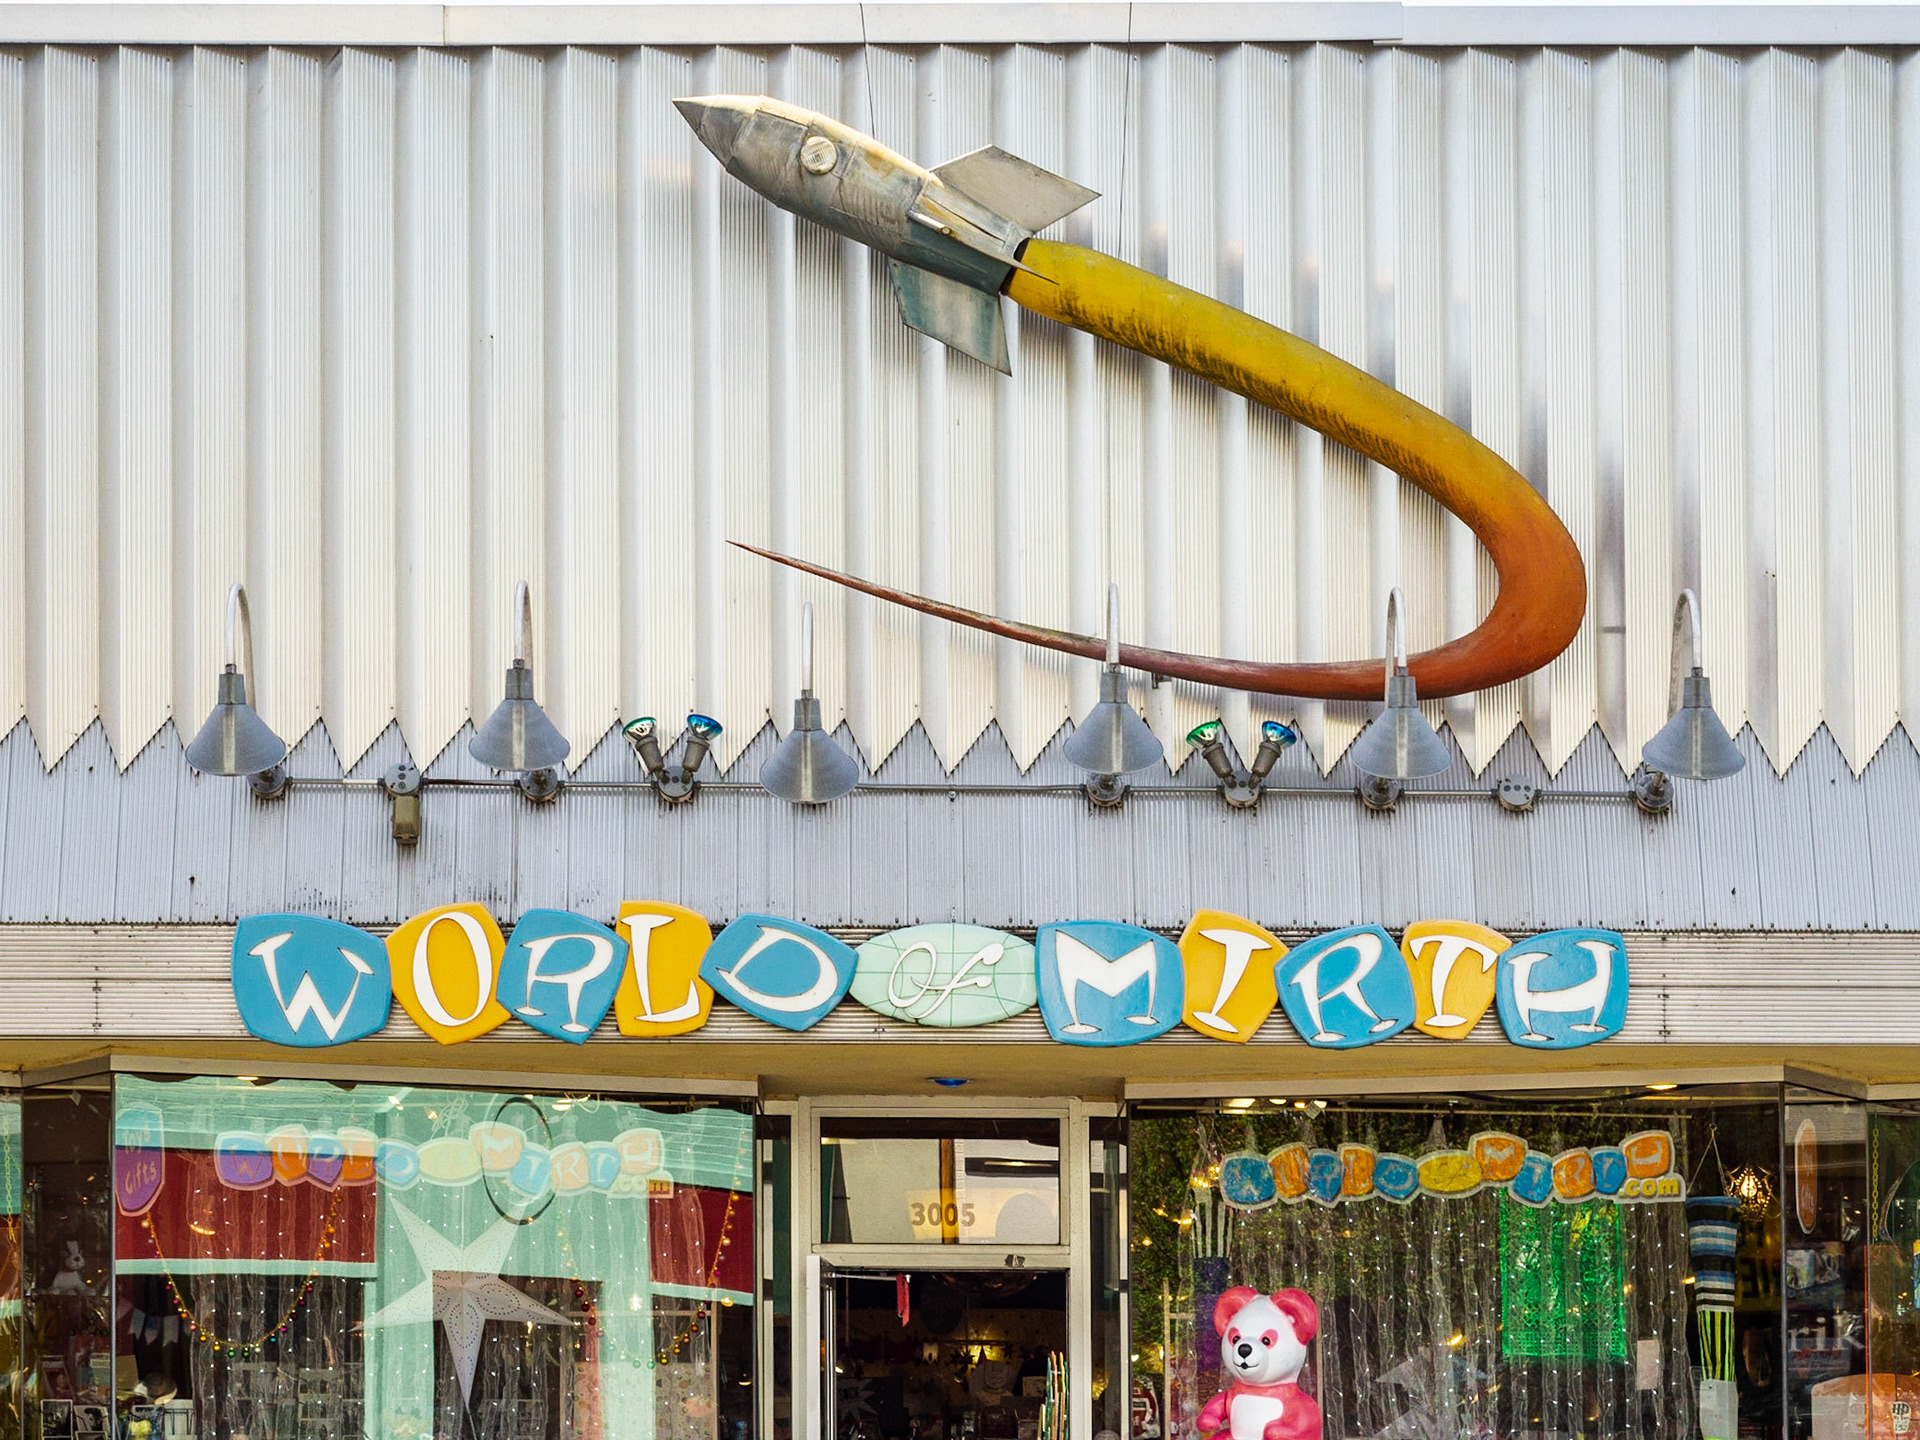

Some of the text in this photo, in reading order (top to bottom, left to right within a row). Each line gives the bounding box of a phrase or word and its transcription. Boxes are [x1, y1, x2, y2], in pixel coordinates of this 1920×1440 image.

[247, 911, 838, 1041] WORLD
[1055, 928, 1618, 1042] MIRTH
[125, 1161, 157, 1194] Gifts
[481, 1132, 657, 1187] MIRTH
[1482, 1140, 1662, 1197] MIRTH
[1619, 1178, 1680, 1197] .com
[911, 1202, 975, 1227] 3005
